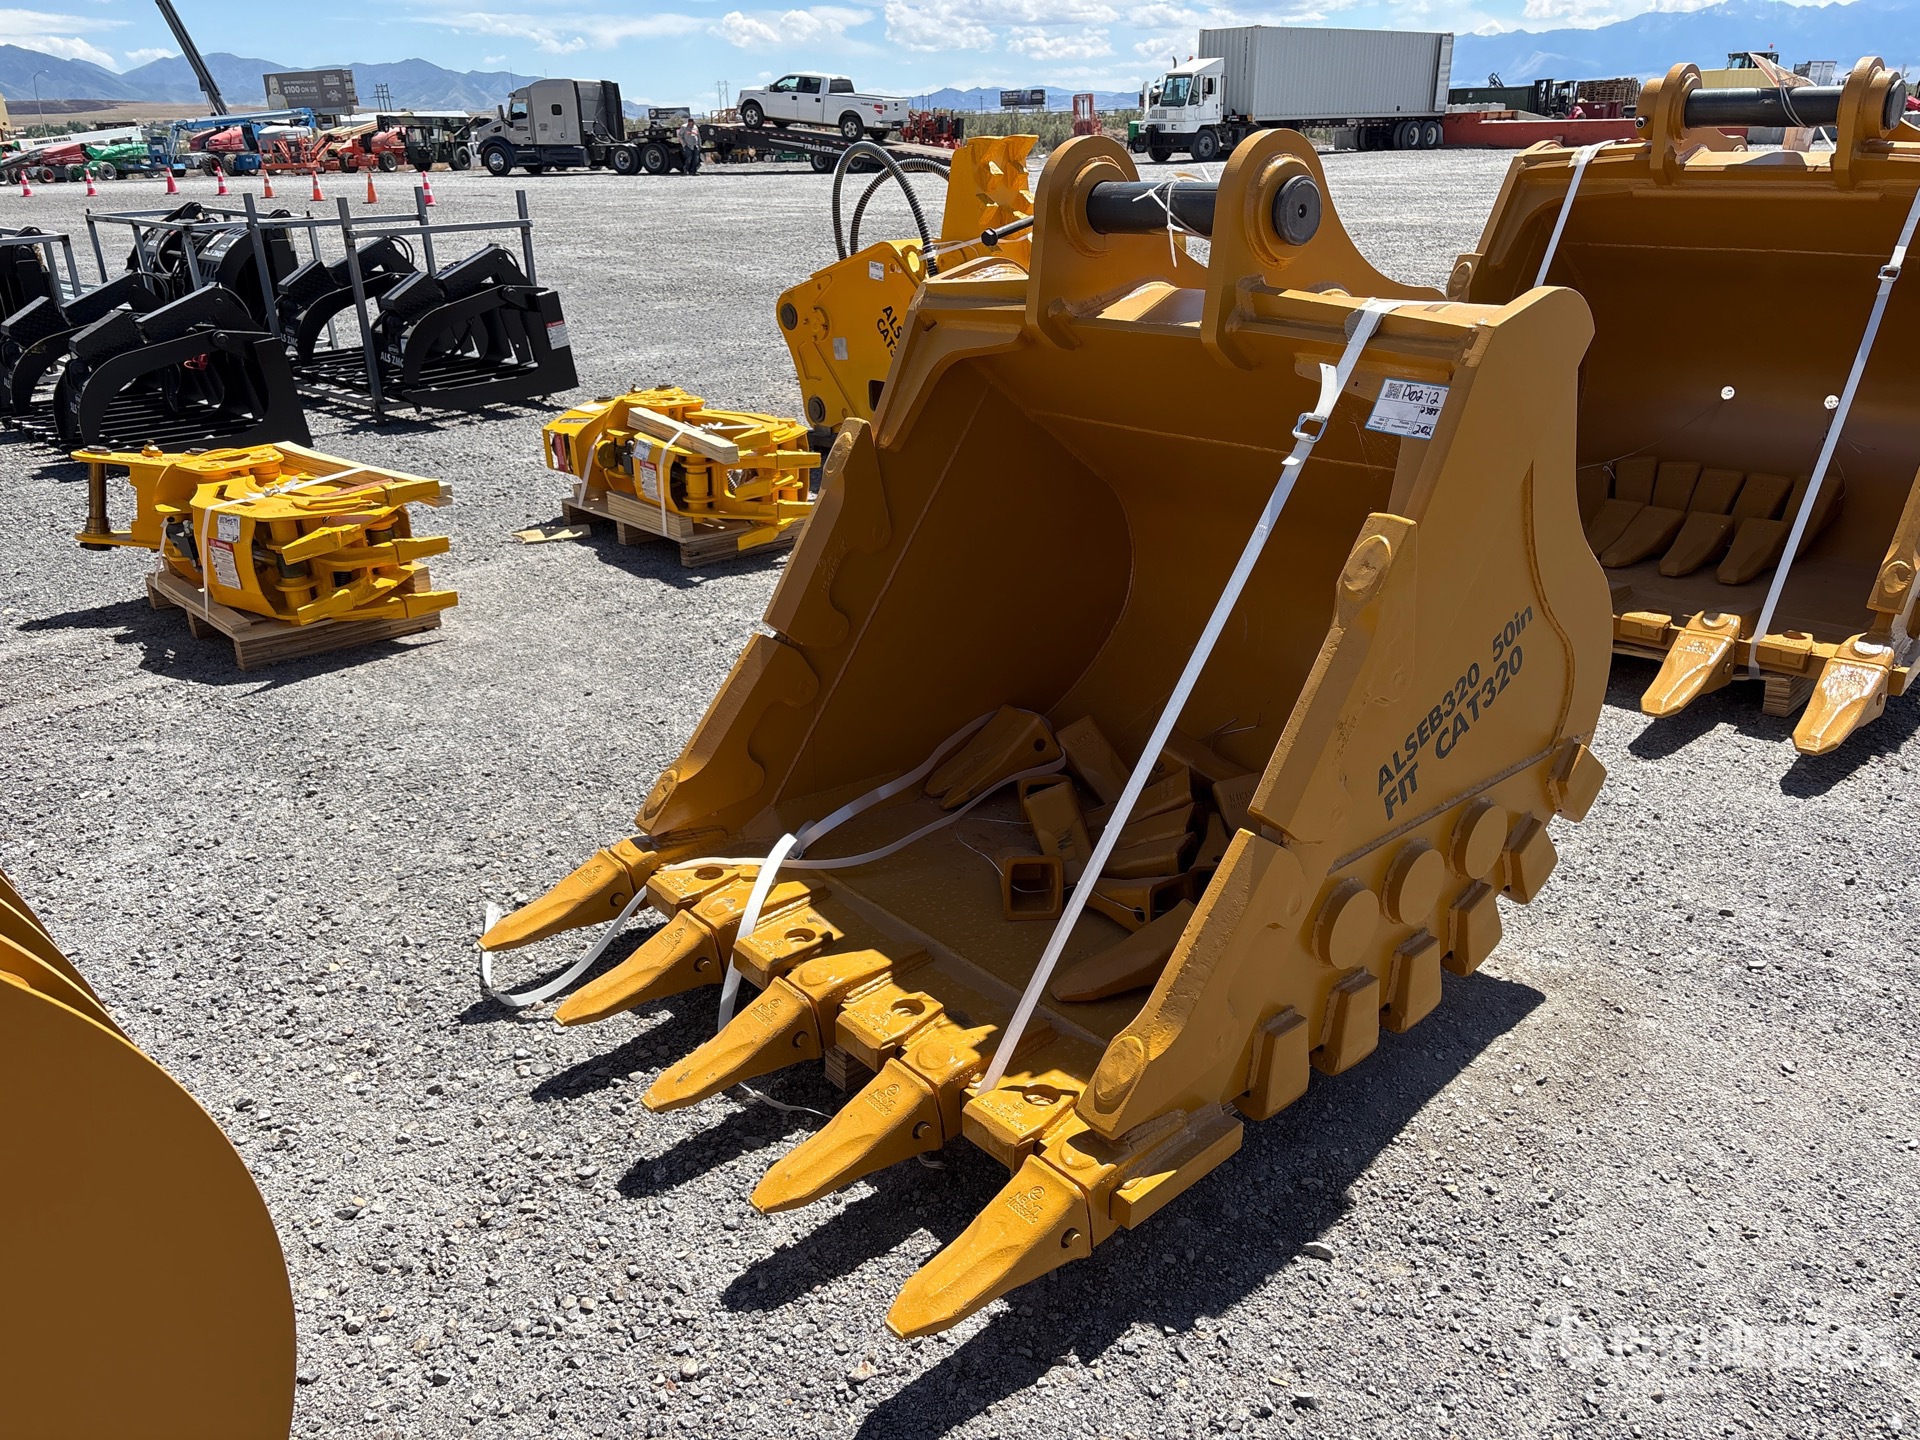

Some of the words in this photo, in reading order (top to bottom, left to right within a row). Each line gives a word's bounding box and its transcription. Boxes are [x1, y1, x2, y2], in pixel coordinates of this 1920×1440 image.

[284, 85, 300, 94] $100
[1377, 662, 1480, 797] ALSEB320
[1492, 605, 1534, 663] 50in
[1383, 760, 1419, 822] FIT
[1435, 645, 1523, 760] CAT320
